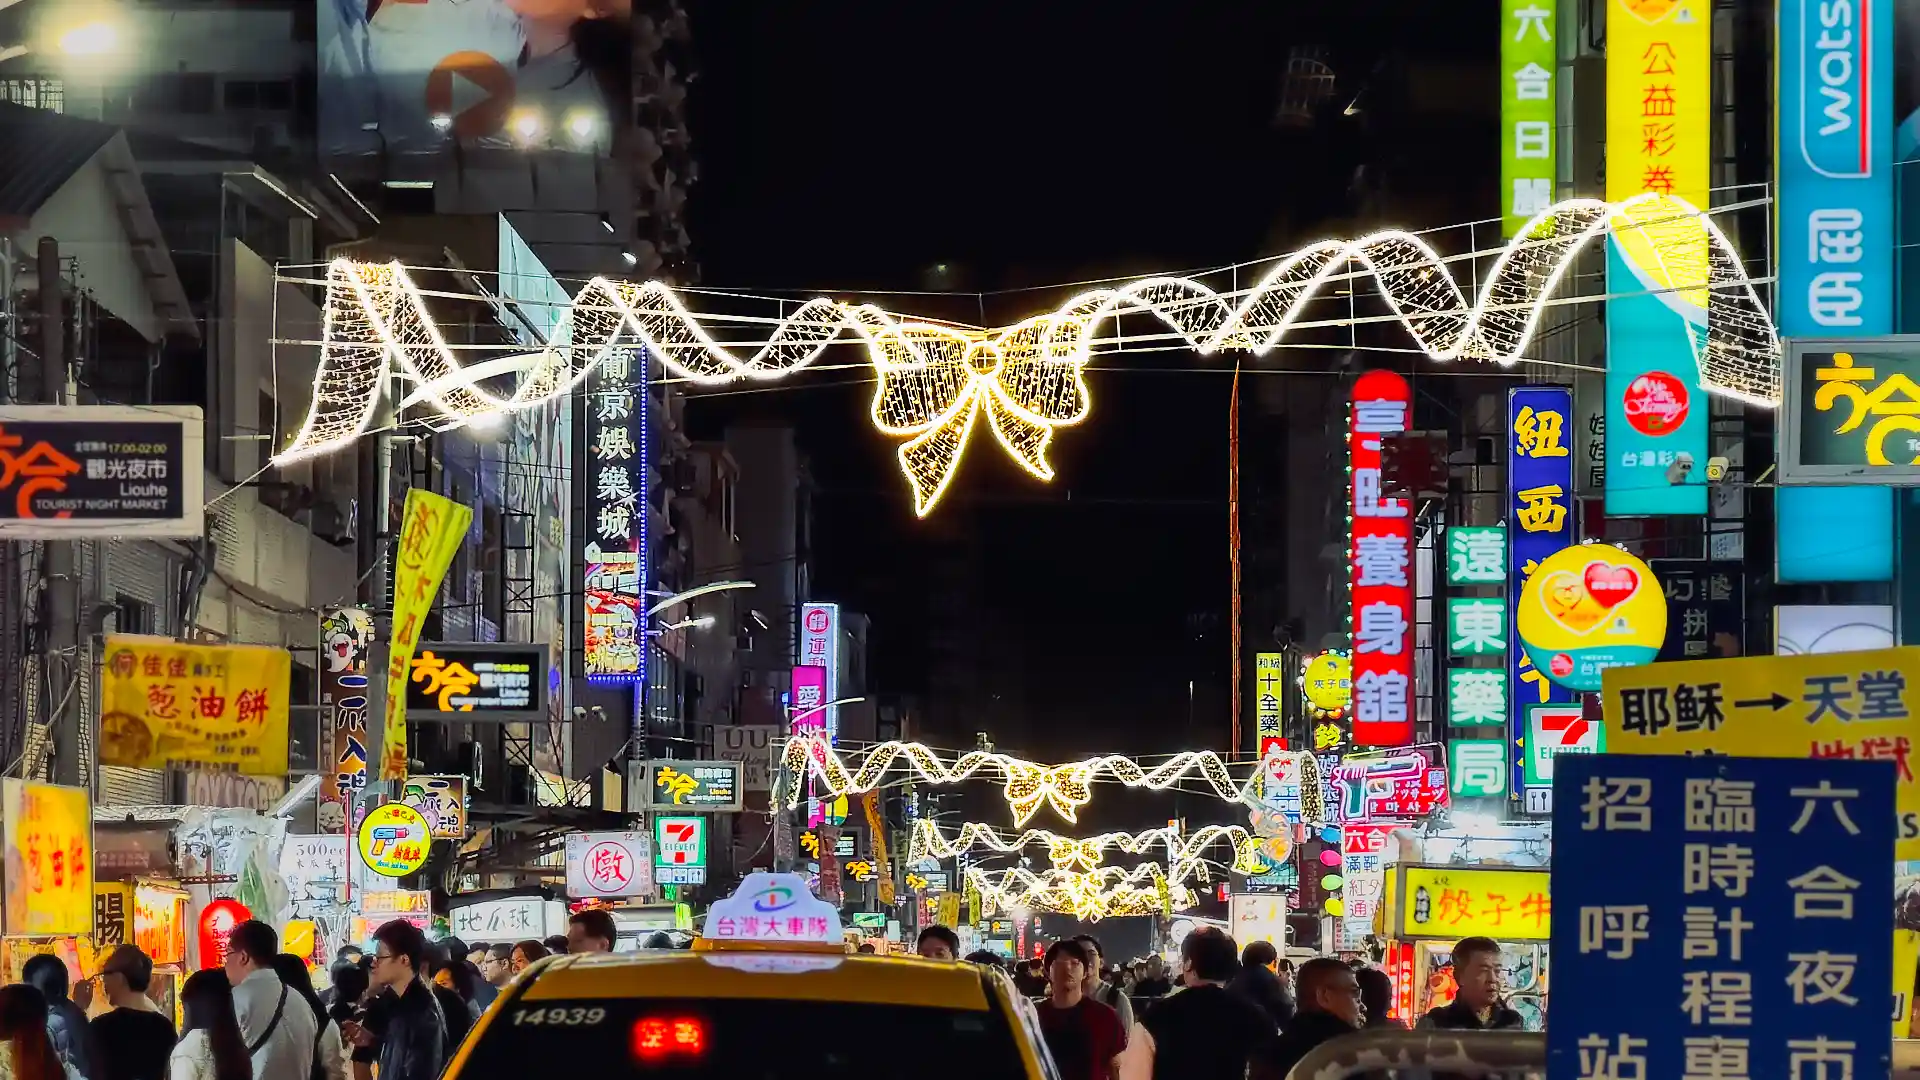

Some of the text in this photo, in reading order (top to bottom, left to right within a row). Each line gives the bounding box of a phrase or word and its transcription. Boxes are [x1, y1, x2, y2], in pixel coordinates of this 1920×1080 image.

[1818, 0, 1852, 136] wats
[1641, 42, 1676, 195] 公益彩券
[86, 459, 167, 479] 觀光夜市
[1622, 451, 1690, 467] 台灣彩
[36, 500, 167, 510] TOURIST NIGHT MARKET
[120, 483, 167, 497] Liouhe
[1451, 530, 1507, 795] 遠東藥局
[1259, 672, 1279, 740] 十全藥
[1803, 670, 1909, 725] 天堂
[1344, 829, 1387, 851] 六合
[591, 849, 628, 883] 燉
[459, 905, 532, 932] 地瓜球
[1438, 888, 1550, 928] 骰子牛
[716, 916, 830, 938] 台灣大車隊
[1577, 776, 1652, 1080] 招呼站
[1680, 777, 1756, 1080] 臨時計程車
[1785, 780, 1862, 1080] 六合夜市
[513, 1008, 606, 1026] 14939
